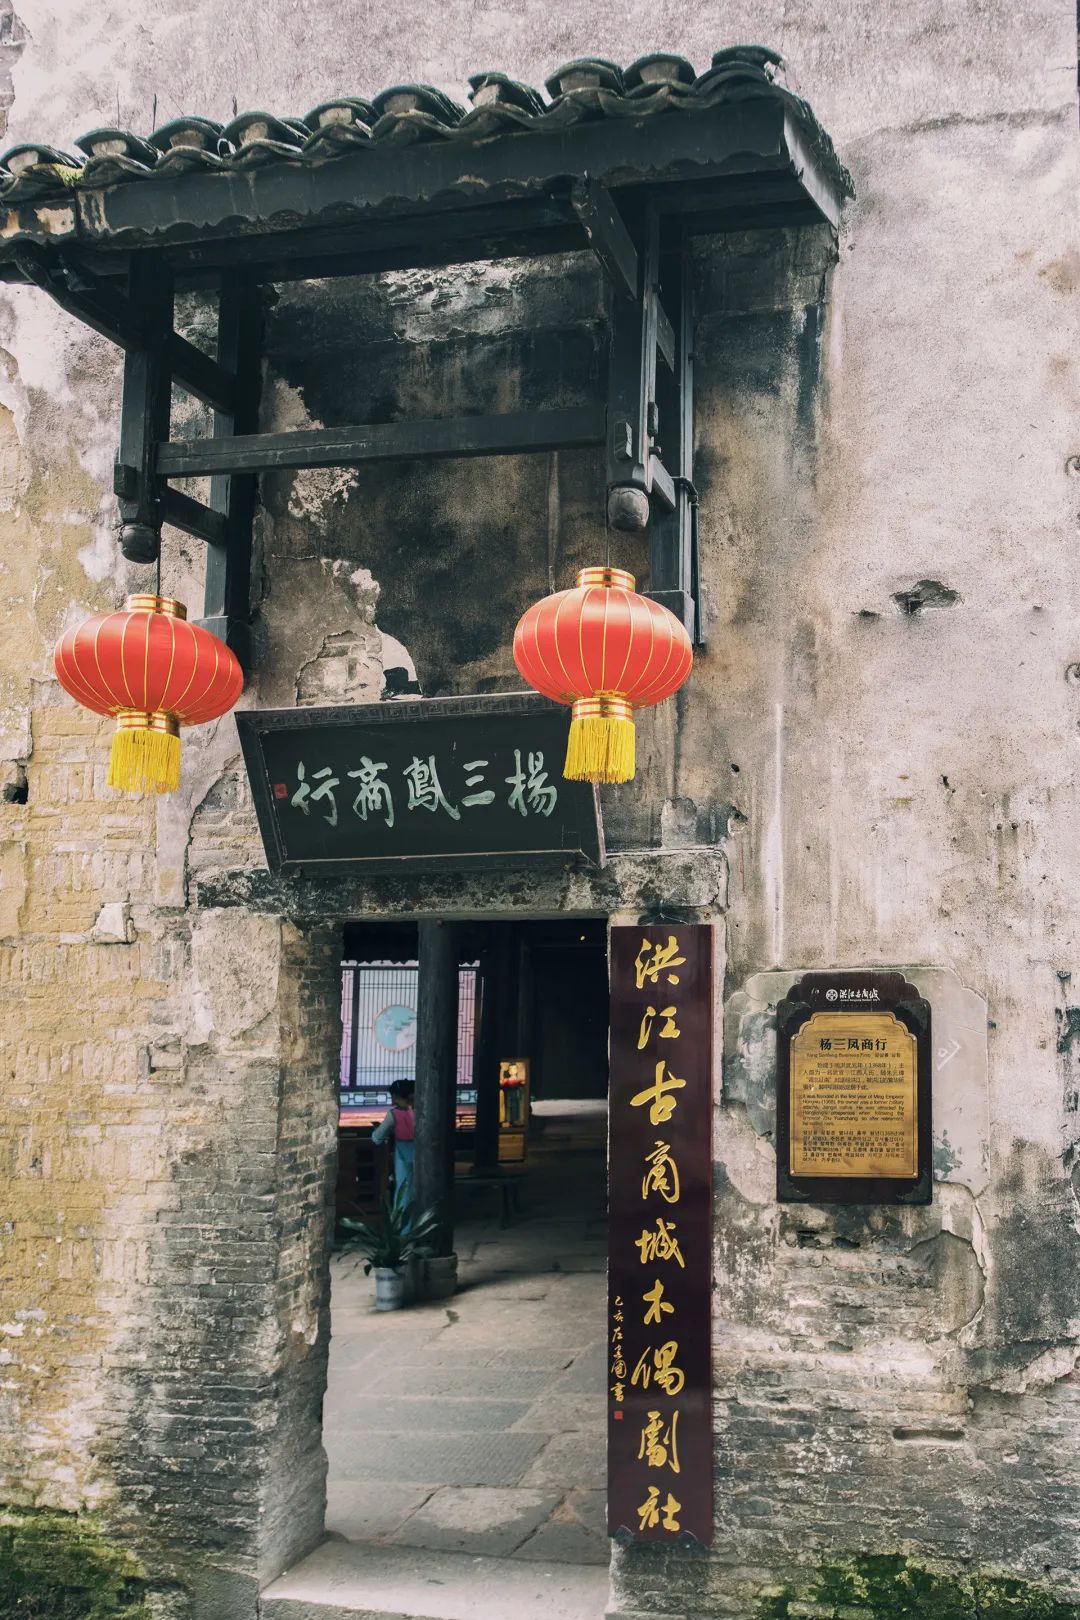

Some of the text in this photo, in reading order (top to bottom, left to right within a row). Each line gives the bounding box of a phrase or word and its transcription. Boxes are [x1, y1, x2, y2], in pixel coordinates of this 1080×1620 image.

[819, 1038, 888, 1051] 杨三凤商行
